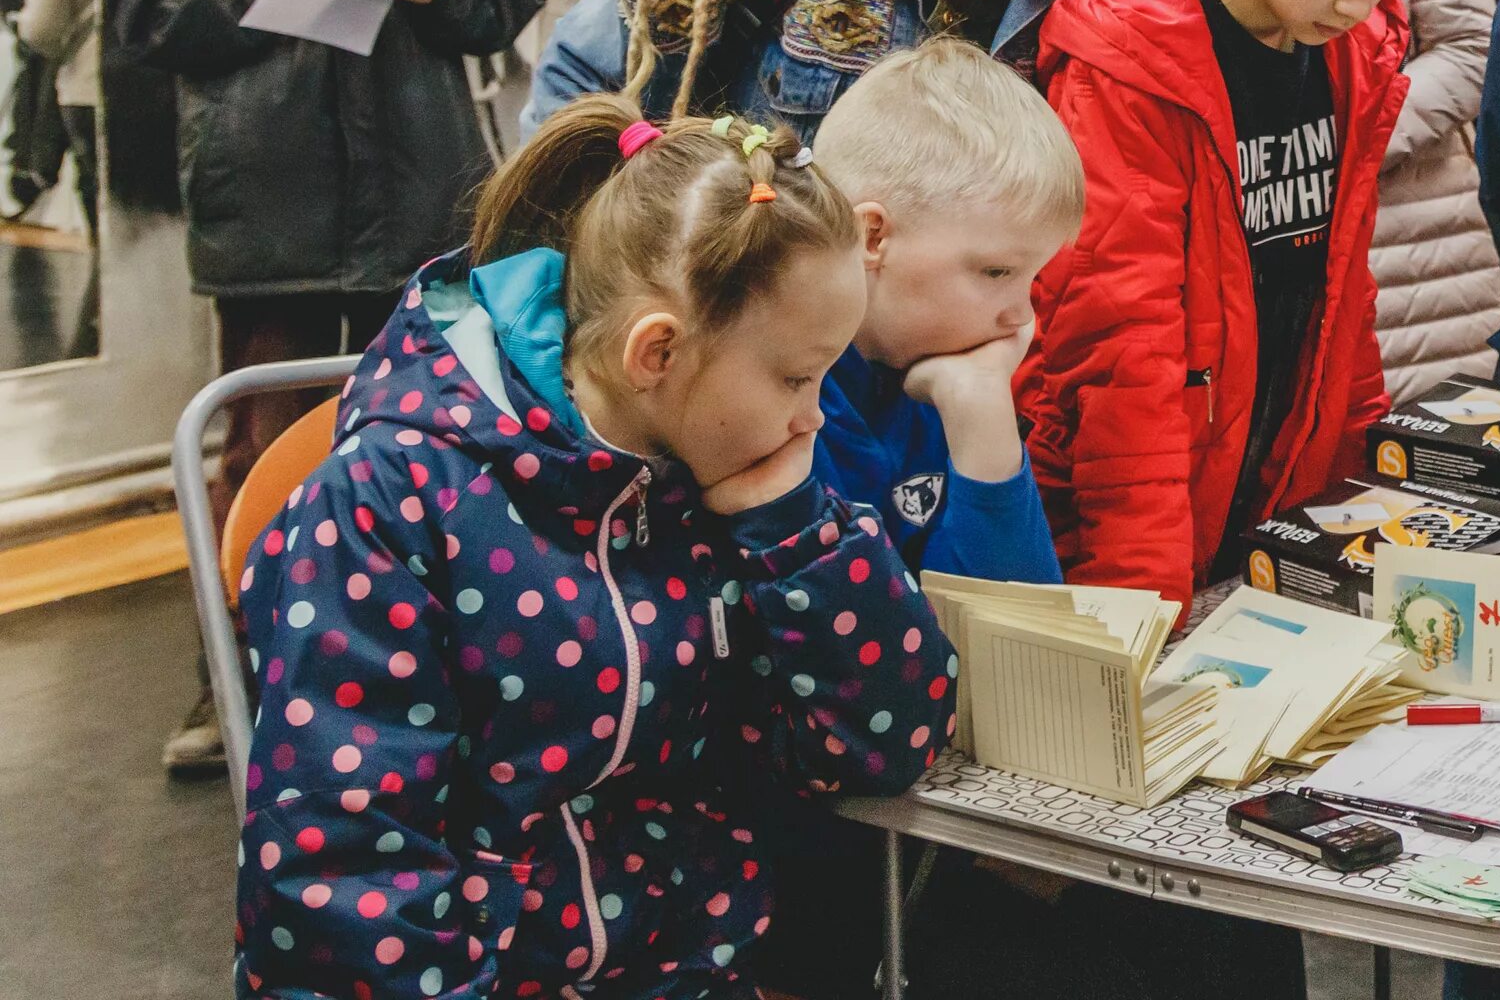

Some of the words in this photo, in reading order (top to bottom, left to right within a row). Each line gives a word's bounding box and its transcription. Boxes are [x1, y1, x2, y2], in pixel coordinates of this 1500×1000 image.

[1281, 114, 1338, 176] TIM
[1241, 168, 1335, 233] MEWHE
[1380, 412, 1452, 435] БЕЙДЖ
[1383, 445, 1402, 476] S
[1256, 519, 1321, 544] БЕЙДЖ
[1253, 554, 1271, 587] S
[1436, 610, 1455, 665] Quest
